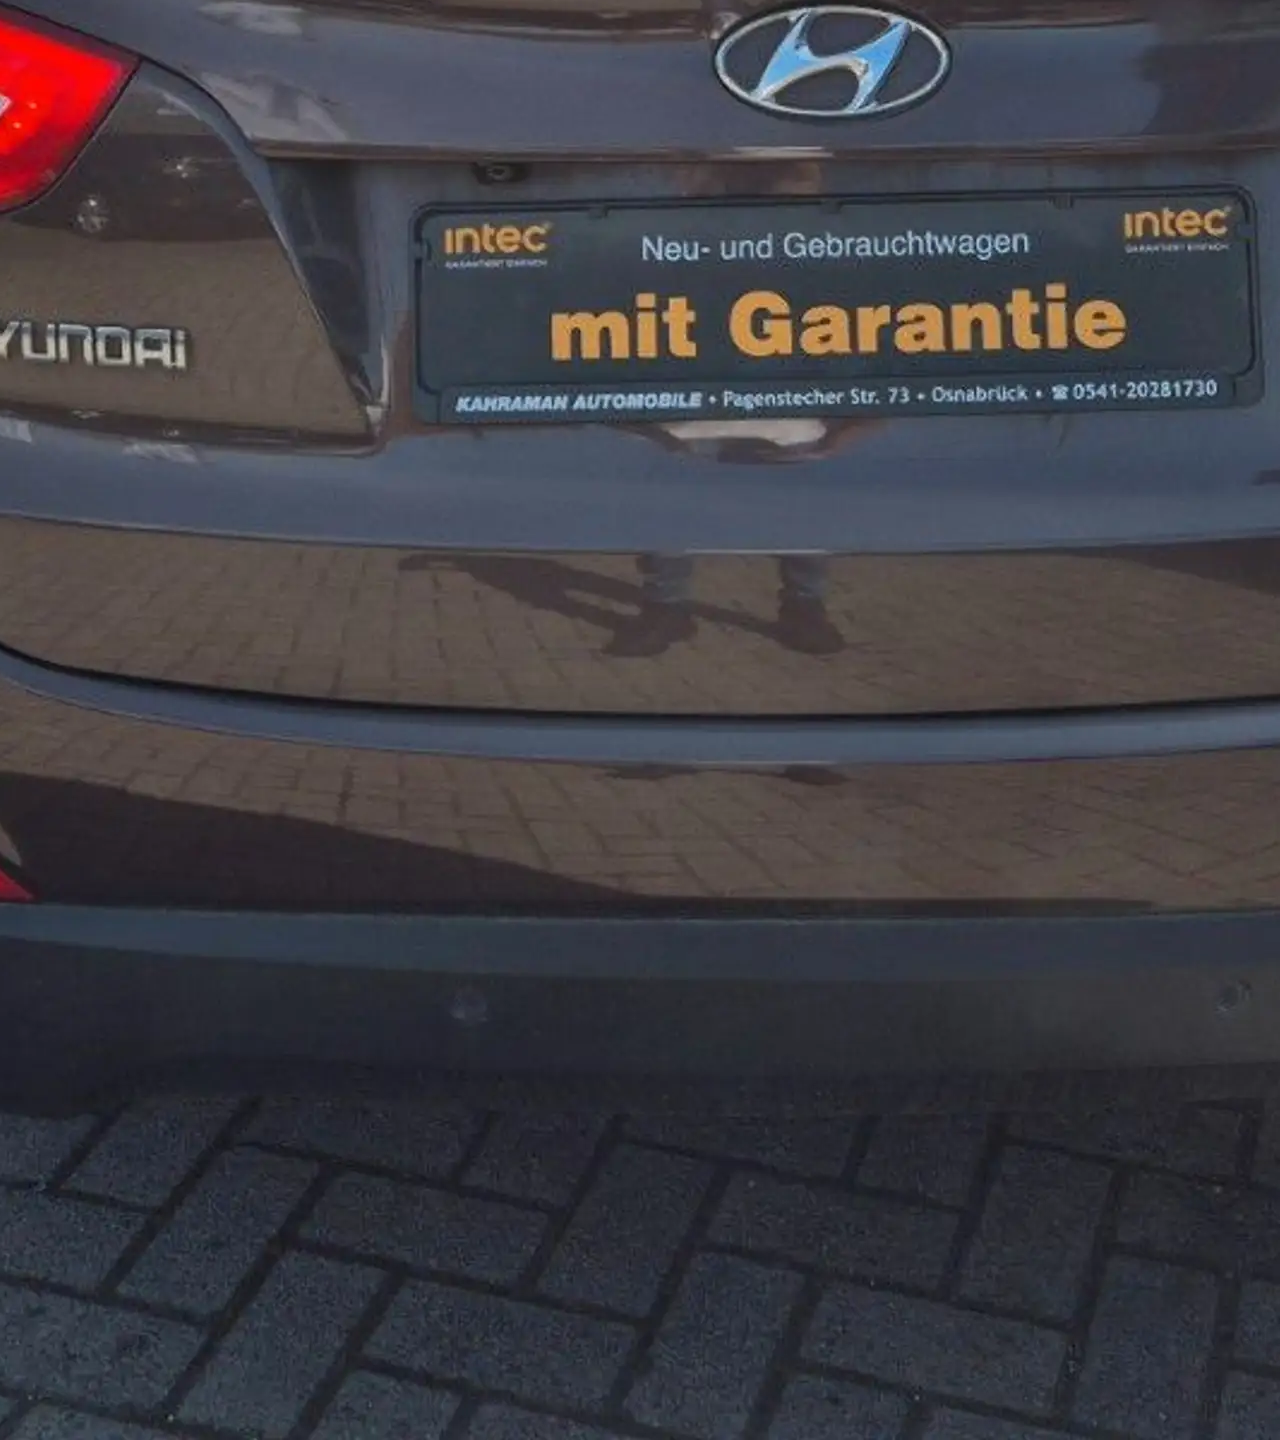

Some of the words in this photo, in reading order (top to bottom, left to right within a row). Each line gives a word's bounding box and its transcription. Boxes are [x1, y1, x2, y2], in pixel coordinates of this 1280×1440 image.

[444, 223, 549, 254] intec
[1124, 207, 1228, 238] intec
[641, 235, 711, 262] Neu-
[720, 232, 773, 261] und
[783, 230, 1030, 261] Gebrauchtwagen
[550, 293, 698, 360] mit
[729, 283, 1128, 358] Garantie
[455, 393, 569, 413] KAHRAMAN
[571, 391, 703, 410] AUTOMOBILE
[723, 389, 845, 410] Pagenstecher
[850, 388, 880, 406] Str.
[889, 387, 910, 404] 73
[931, 385, 1028, 403] Osnabrück
[1072, 379, 1219, 400] 0541-20281730
